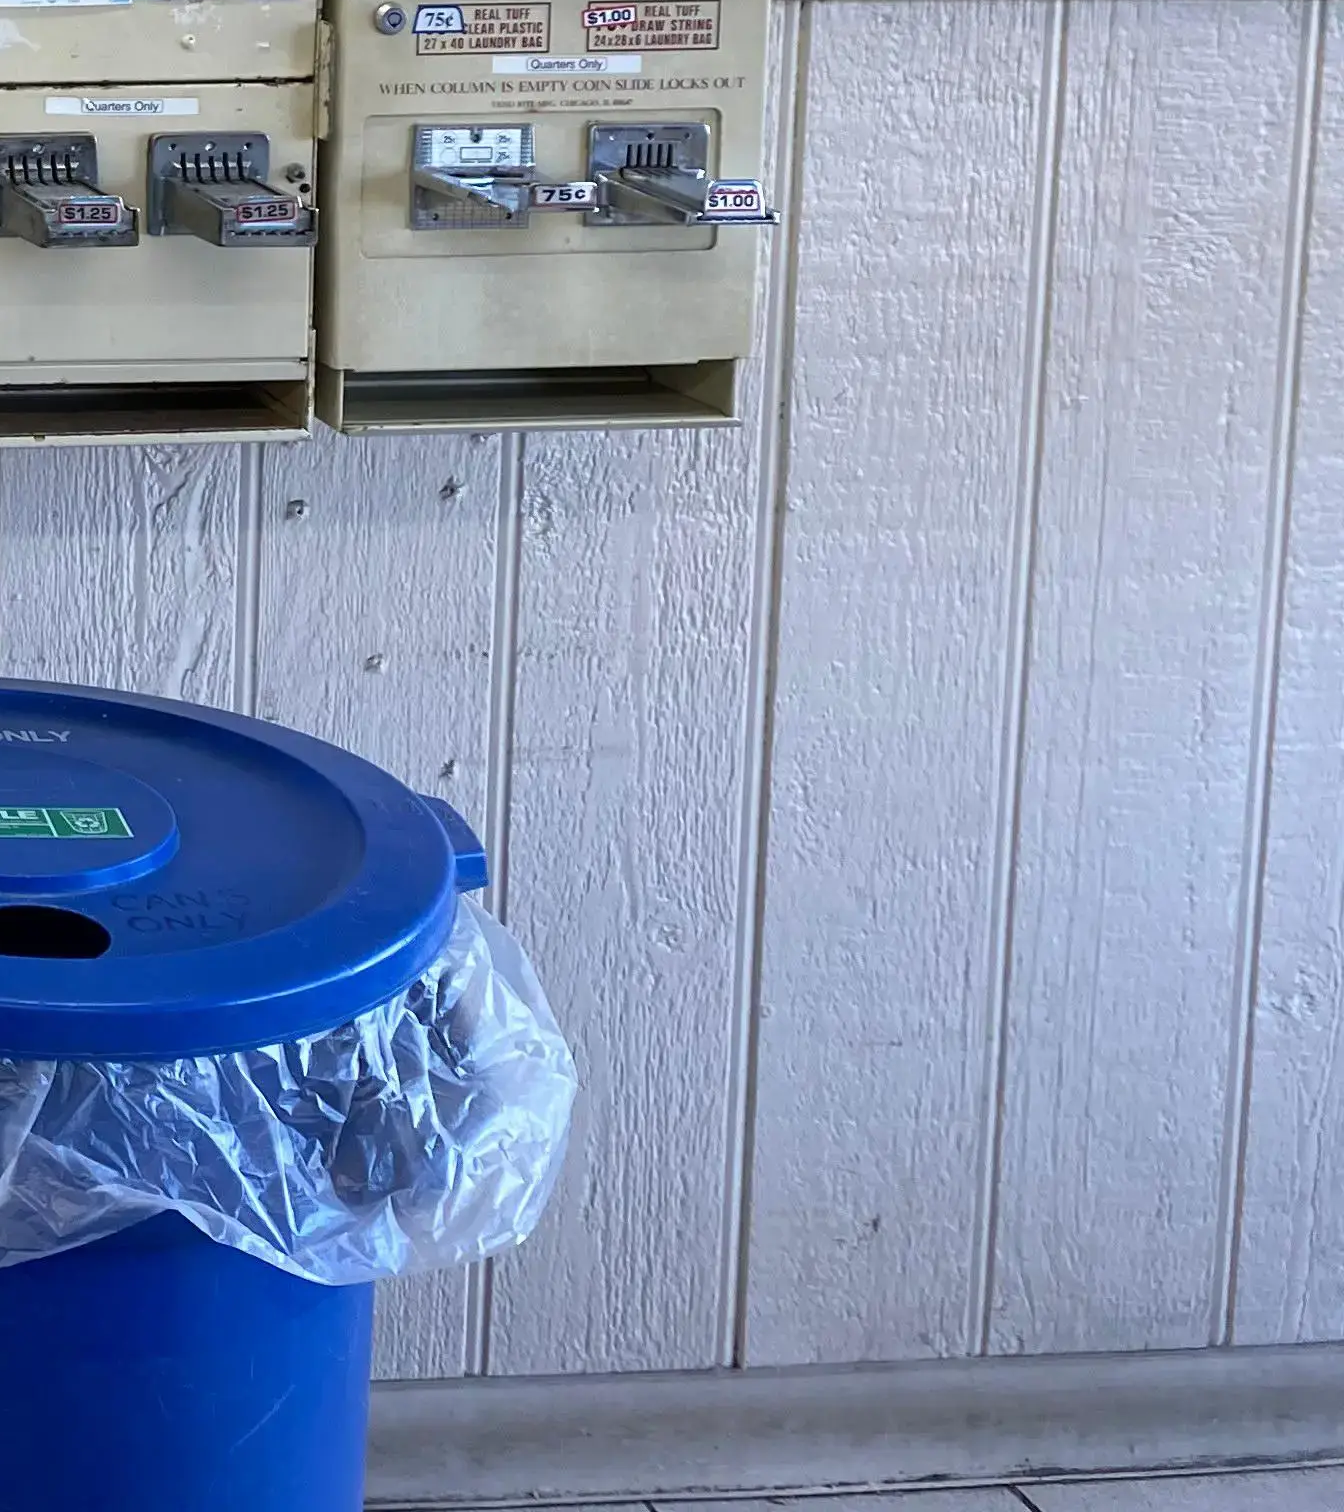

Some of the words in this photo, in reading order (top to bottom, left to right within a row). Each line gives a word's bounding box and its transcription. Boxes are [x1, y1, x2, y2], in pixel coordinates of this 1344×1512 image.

[474, 8, 502, 20] REAL
[505, 8, 530, 20] TUFF
[587, 8, 632, 24] $1.00
[644, 6, 672, 18] REAL
[675, 4, 701, 16] TUFF
[424, 12, 455, 28] 75¢
[632, 20, 666, 32] DRAW
[671, 18, 713, 31] STRING
[462, 22, 495, 35] CLEAR
[500, 22, 544, 34] PLASTIC
[423, 38, 438, 50] 27
[440, 40, 448, 50] x
[450, 38, 465, 50] 40
[468, 36, 517, 50] LAUNDRY
[522, 36, 543, 48] BAG
[530, 58, 576, 70] Quarters
[578, 58, 604, 72] Only
[379, 84, 426, 96] WHEN
[430, 82, 496, 95] COLUMN
[501, 82, 514, 94] IS
[518, 80, 568, 94] EMPTY
[572, 80, 610, 92] COIN
[616, 78, 656, 92] SLIDE
[660, 77, 709, 90] LOCKS
[714, 76, 746, 90] OUT
[86, 100, 132, 113] Quarters
[134, 100, 160, 114] Only
[542, 188, 587, 203] 75¢
[708, 194, 754, 208] $1.00
[64, 207, 112, 220] $1.25
[240, 204, 290, 218] $1.25
